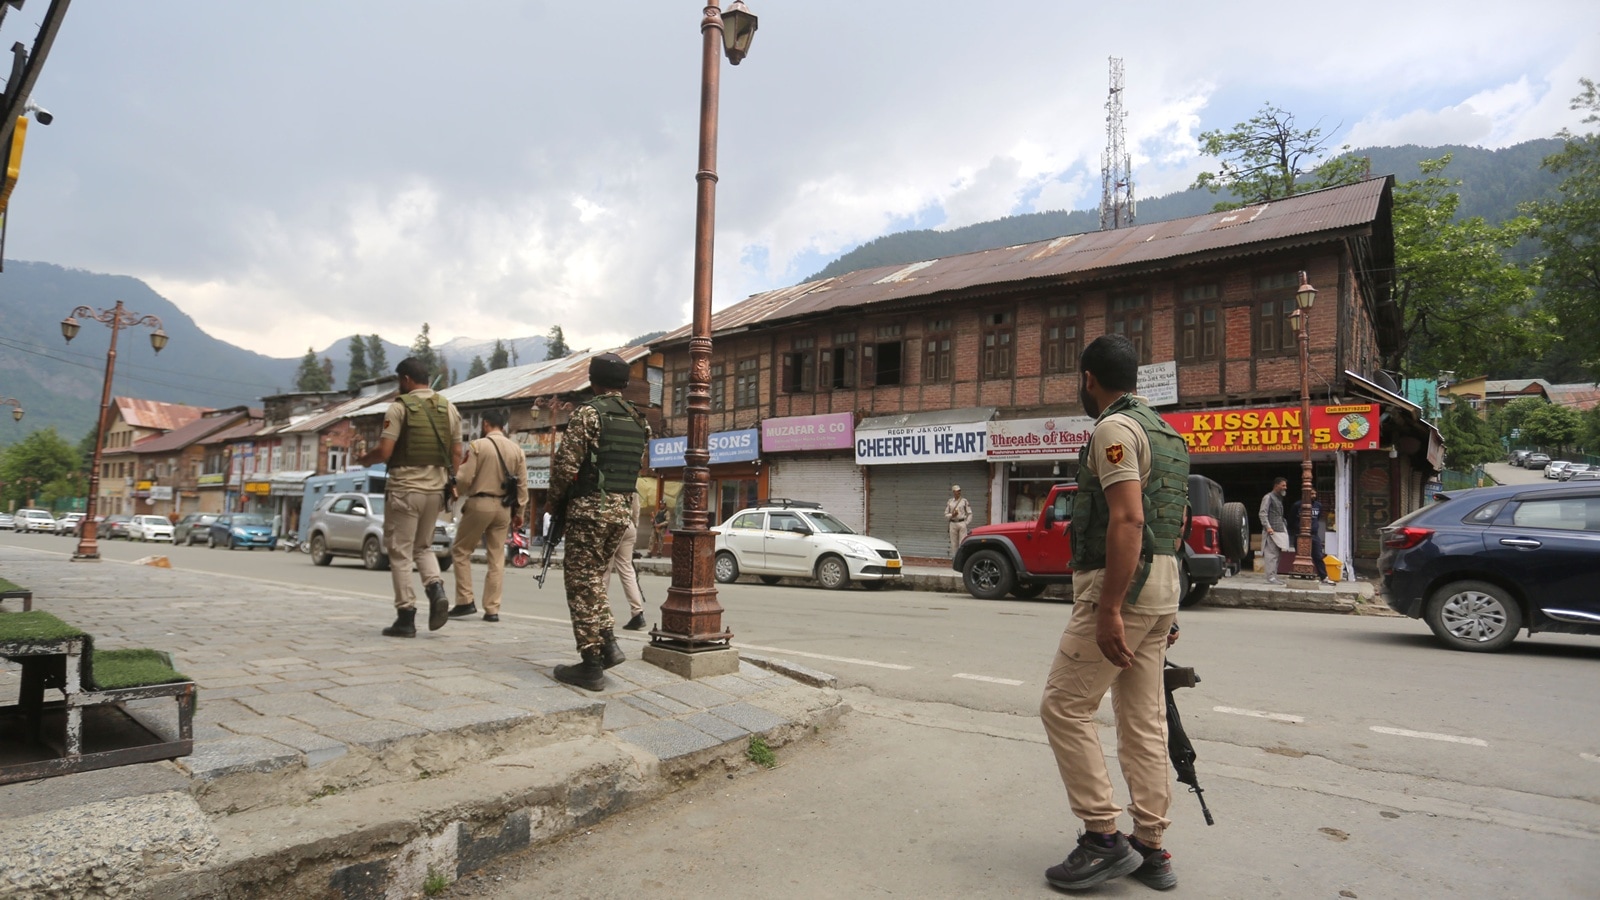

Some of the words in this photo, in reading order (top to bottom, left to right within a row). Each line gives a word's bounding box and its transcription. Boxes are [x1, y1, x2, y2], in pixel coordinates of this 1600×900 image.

[766, 425, 815, 437] MUZAFAR
[818, 424, 827, 434] &
[829, 422, 845, 433] CO
[1192, 411, 1301, 431] KISSAN
[654, 441, 687, 455] GAN
[708, 433, 752, 450] SONS
[857, 435, 930, 458] CHEERFUL
[934, 431, 987, 454] HEART
[990, 432, 1041, 447] Threads
[1043, 431, 1058, 446] of
[1059, 430, 1091, 445] Kash
[1181, 432, 1213, 447] RY
[1224, 428, 1331, 446] FRUITS
[1267, 443, 1318, 451] INDUSTRS
